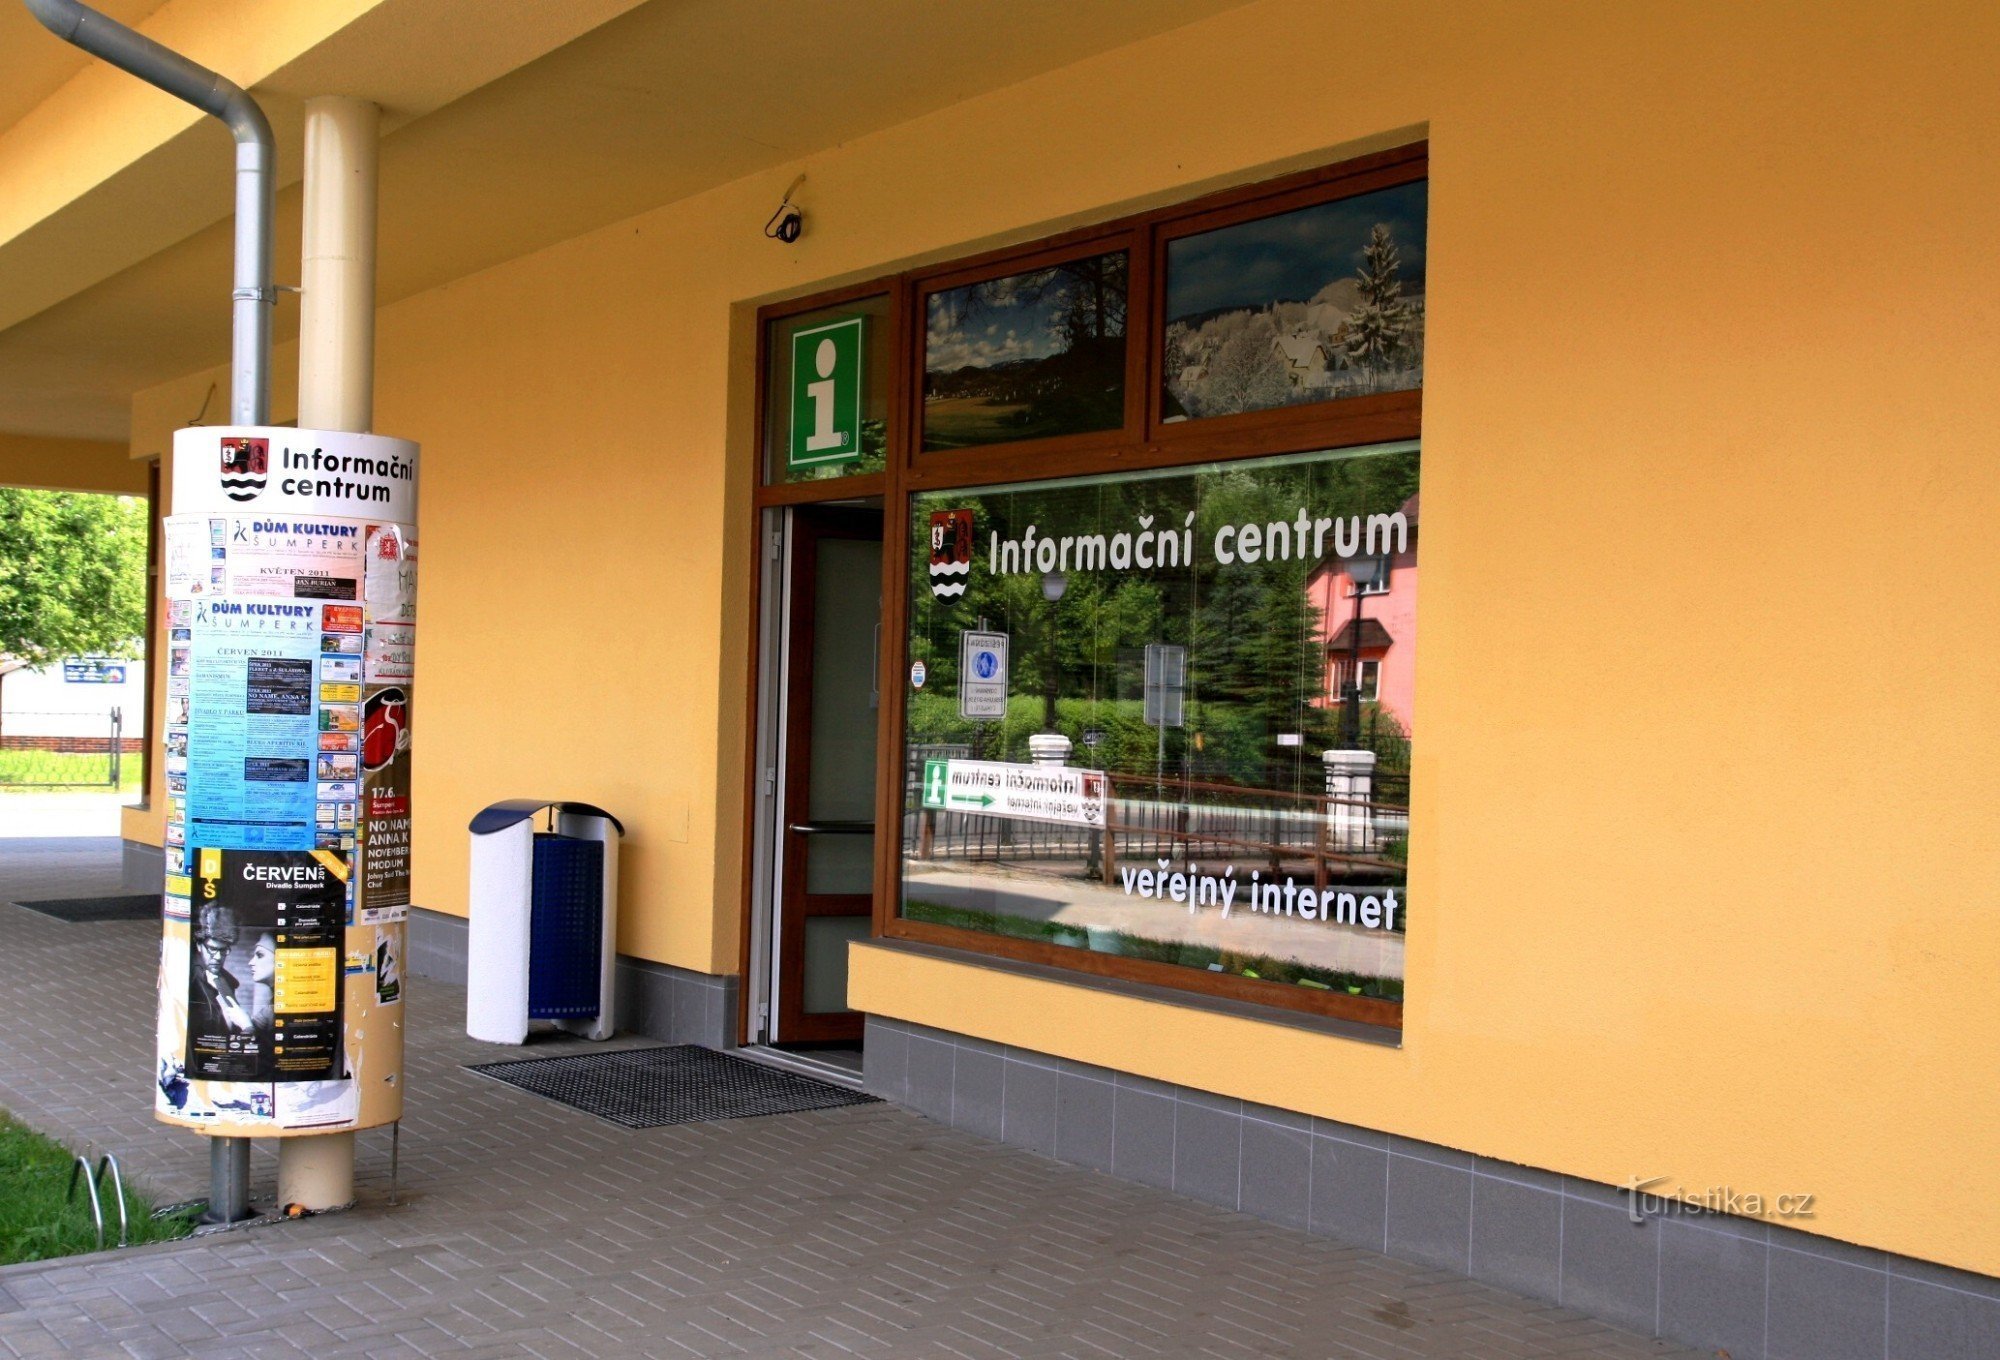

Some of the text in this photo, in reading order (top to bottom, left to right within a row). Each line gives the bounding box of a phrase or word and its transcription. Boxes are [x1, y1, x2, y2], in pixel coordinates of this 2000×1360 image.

[283, 447, 413, 481] Informační
[281, 477, 390, 502] centrum
[253, 519, 358, 537] DŮM KULTURY
[990, 508, 1407, 576] Informační centrum
[212, 600, 313, 617] DŮM KULTURY
[372, 787, 395, 799] 17.6.
[369, 820, 387, 832] NO
[368, 831, 409, 846] ANNA K
[243, 863, 317, 880] ČERVEN
[294, 881, 324, 890] Šumperk
[1121, 859, 1398, 930] veřejný internet
